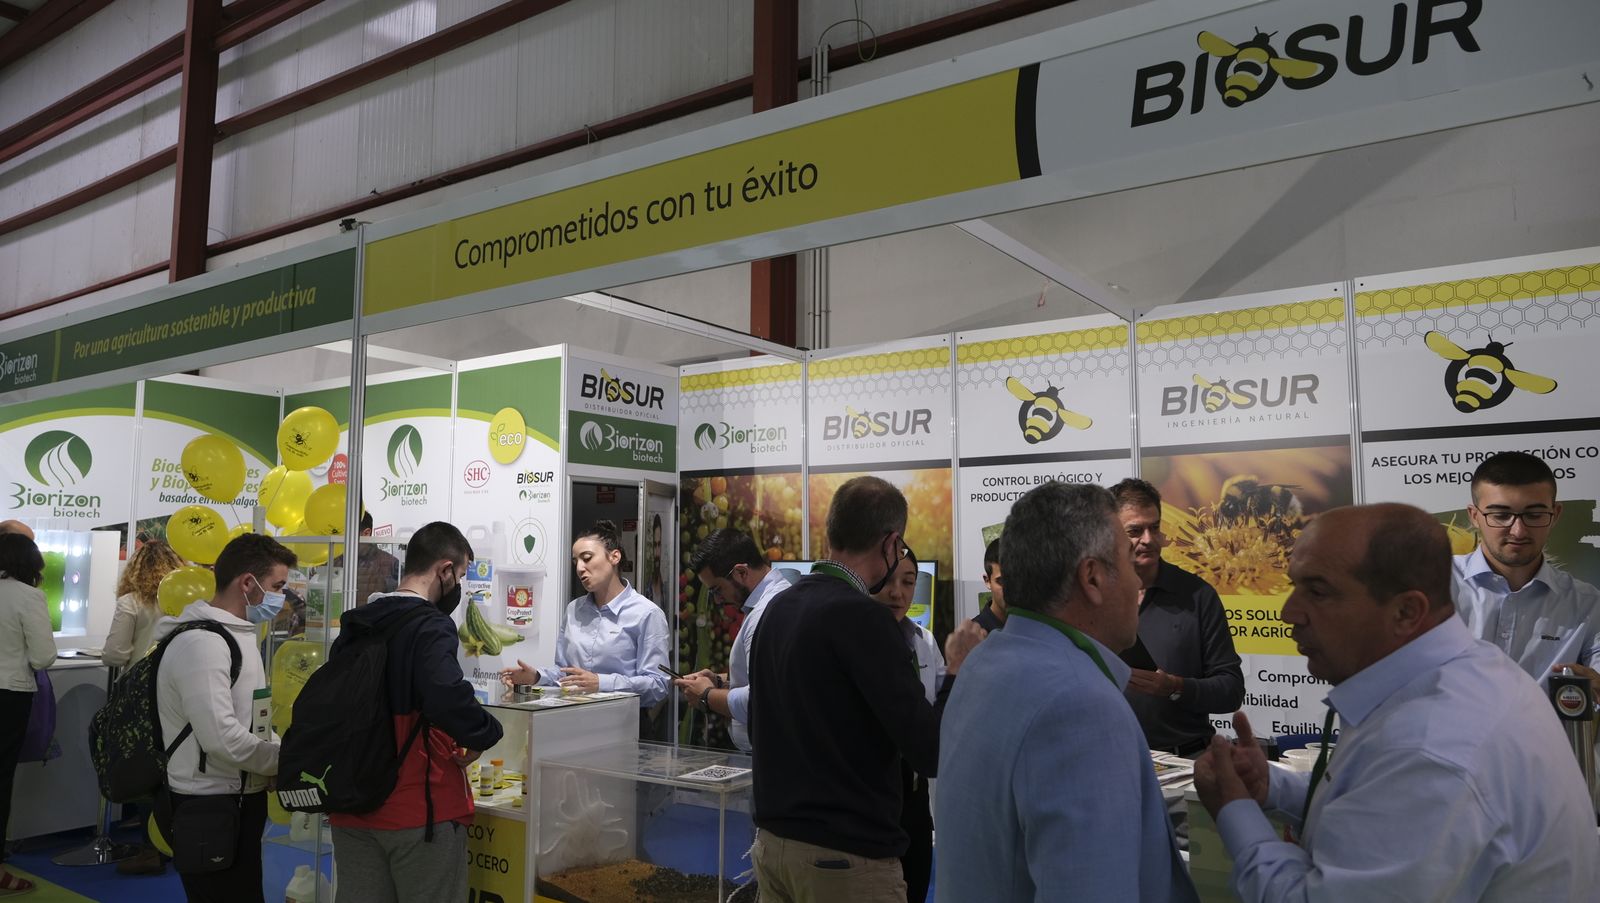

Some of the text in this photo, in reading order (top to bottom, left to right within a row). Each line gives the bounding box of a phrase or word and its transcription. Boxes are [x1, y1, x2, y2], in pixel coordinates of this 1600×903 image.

[1131, 0, 1483, 128] BIOSUR
[455, 159, 819, 269] Comprometidos con tu éxito
[73, 286, 317, 360] Por una agricultura sostenible y productiva
[580, 371, 665, 410] BIOSUR
[1161, 373, 1320, 416] BIOSUR
[584, 402, 660, 420] DISTRIBUIDOR OFICIAL
[823, 408, 932, 441] BIOSUR
[1167, 412, 1310, 429] INGENIERÍA NATURAL
[498, 432, 522, 446] eco
[604, 423, 663, 453] Biorizon
[719, 421, 787, 450] Biorizon
[750, 443, 788, 454] biotech
[826, 438, 925, 452] DISTRIBUIDOR OFICIAL
[632, 450, 663, 463] biotech
[1371, 454, 1438, 467] ASEGURA
[1441, 452, 1460, 464] TU
[1466, 445, 1571, 463] PROCIÓN
[467, 466, 488, 482] SHC
[516, 471, 554, 484] BIOSUR
[982, 475, 1031, 487] CONTROL
[1095, 472, 1103, 482] Y
[1404, 473, 1432, 484] LOS
[1436, 471, 1473, 485] MEJO
[150, 477, 160, 491] y
[380, 476, 428, 501] Biorizon
[8, 481, 101, 509] Biorizon
[159, 491, 197, 504] basados
[401, 495, 428, 507] biotech
[53, 506, 101, 518] biotech
[1225, 609, 1282, 621] OS SOLU
[278, 787, 322, 808] PUMA
[476, 852, 509, 874] CERO
